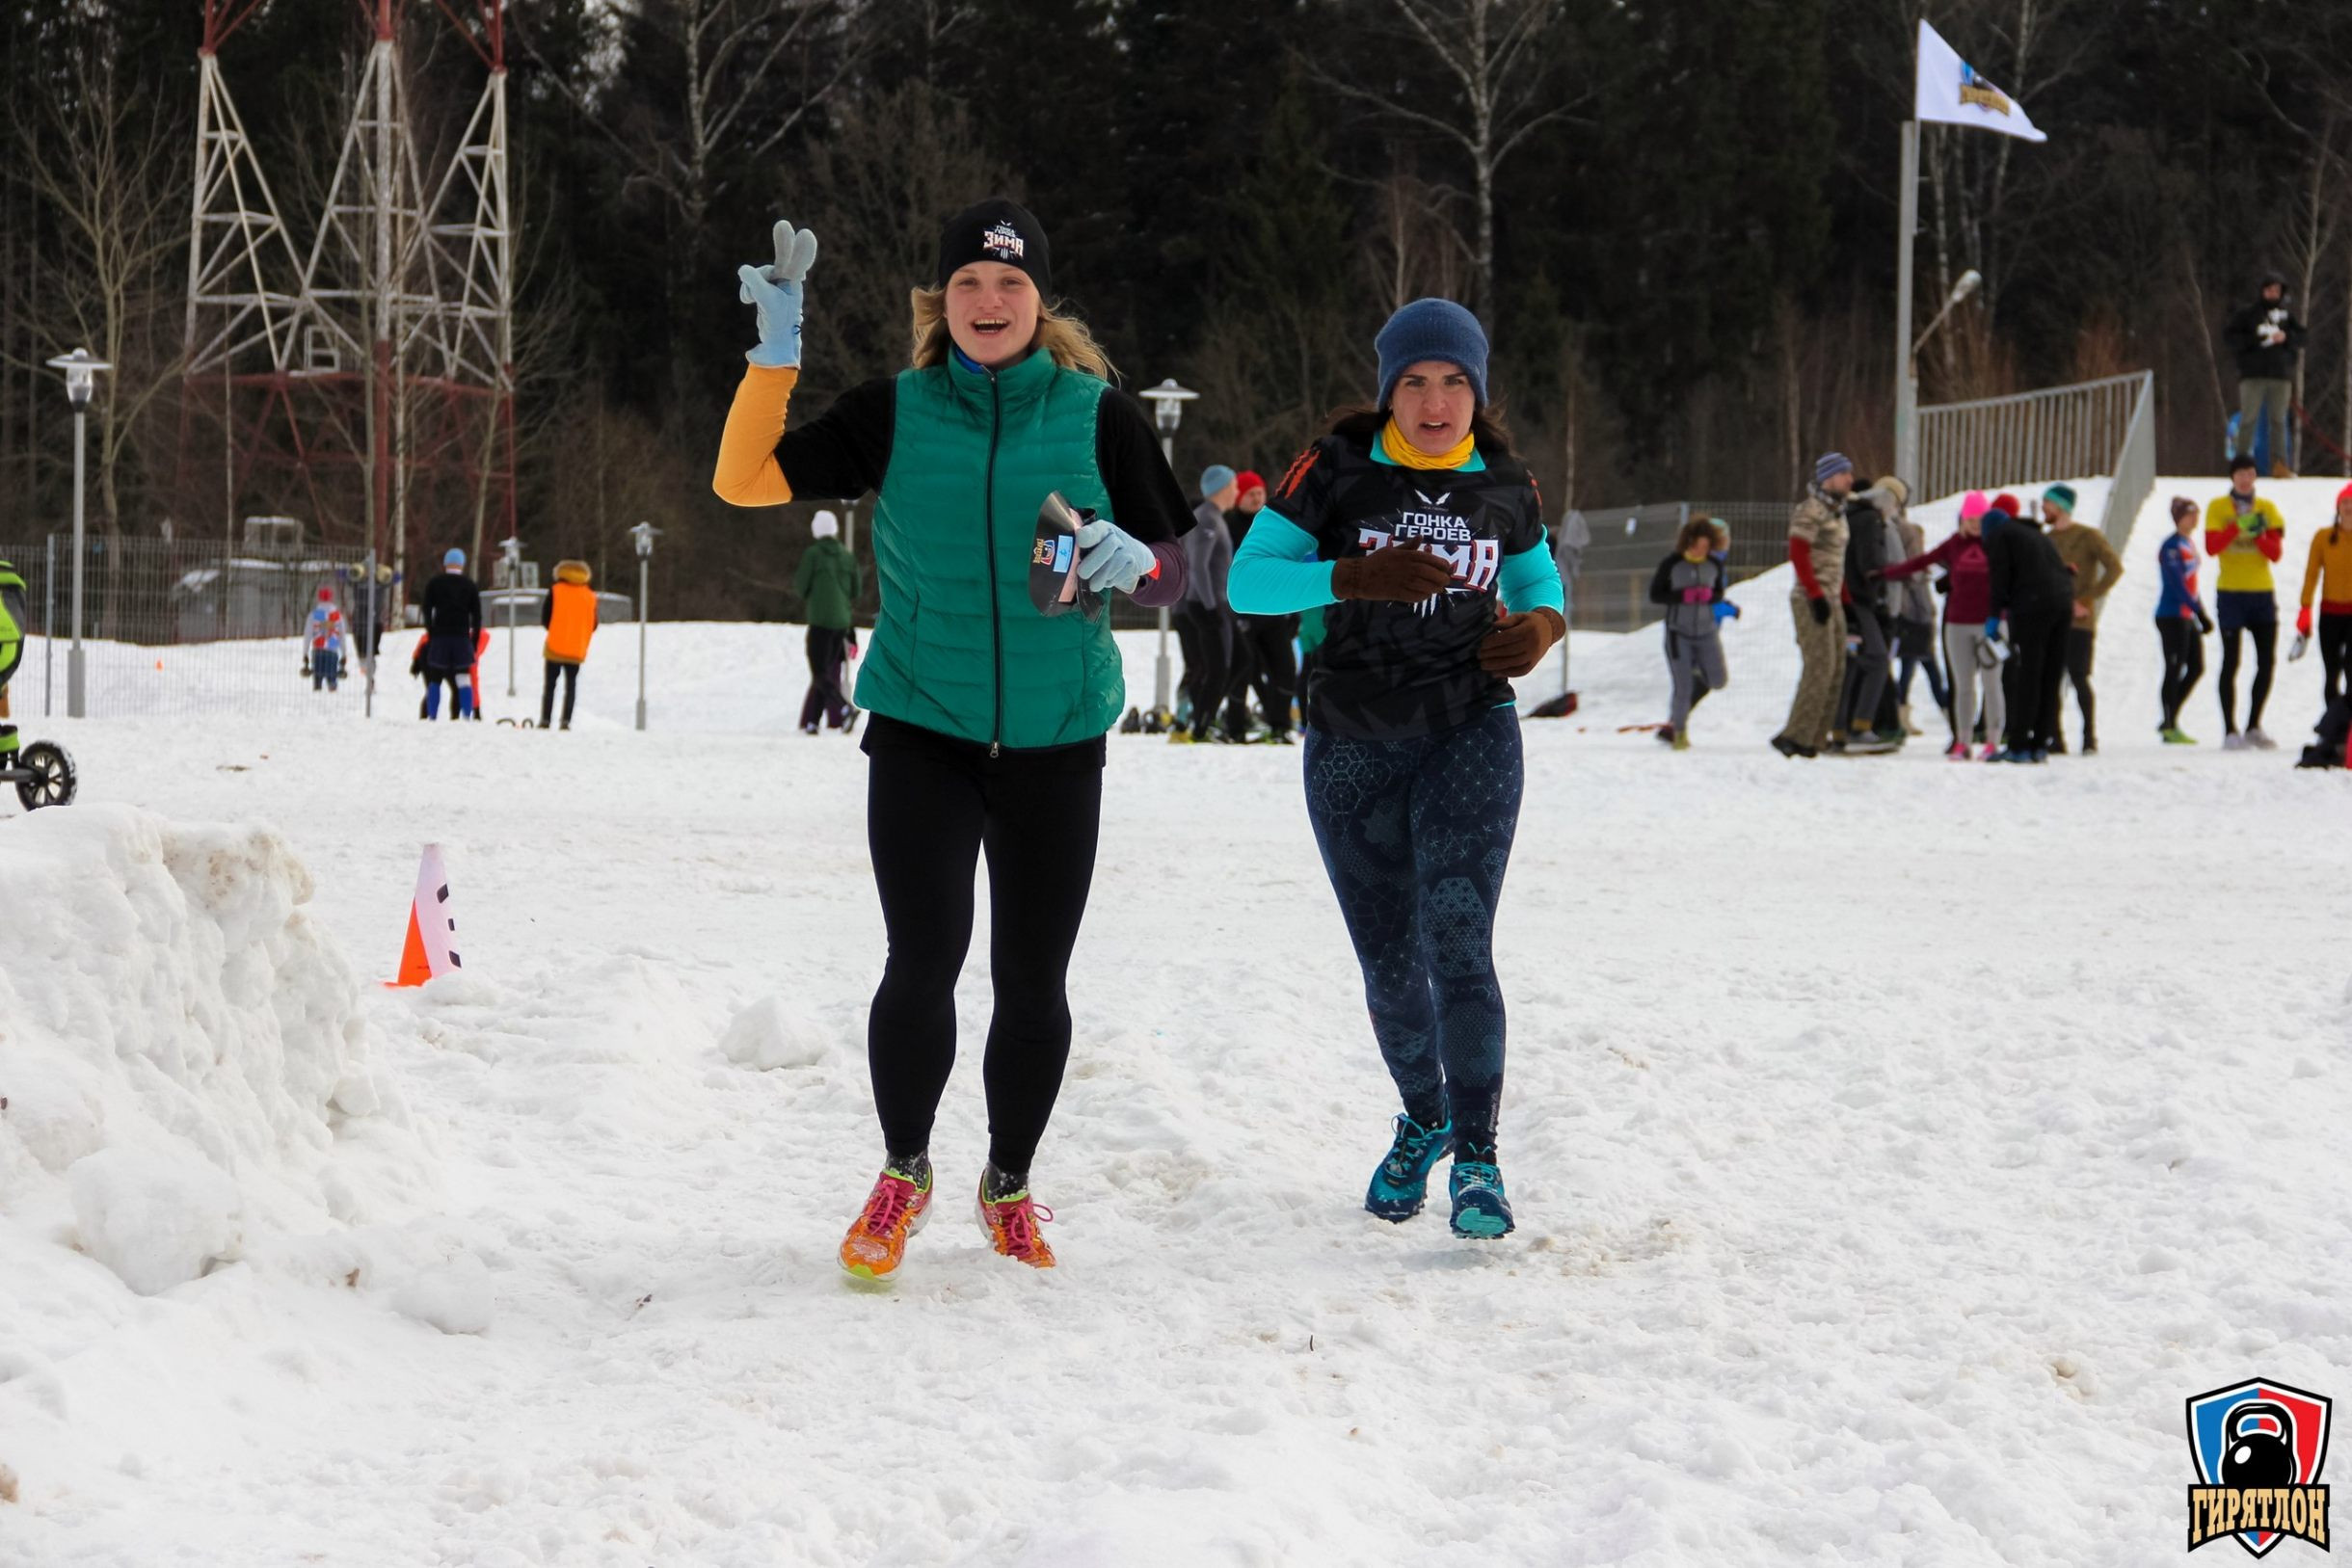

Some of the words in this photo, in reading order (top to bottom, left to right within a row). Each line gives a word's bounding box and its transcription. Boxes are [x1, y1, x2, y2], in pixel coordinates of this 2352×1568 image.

[983, 231, 1024, 256] ЗИМА
[1402, 512, 1466, 528] ГОНКА
[1395, 524, 1471, 542] ГЕРОЕВ
[1358, 527, 1499, 591] МА
